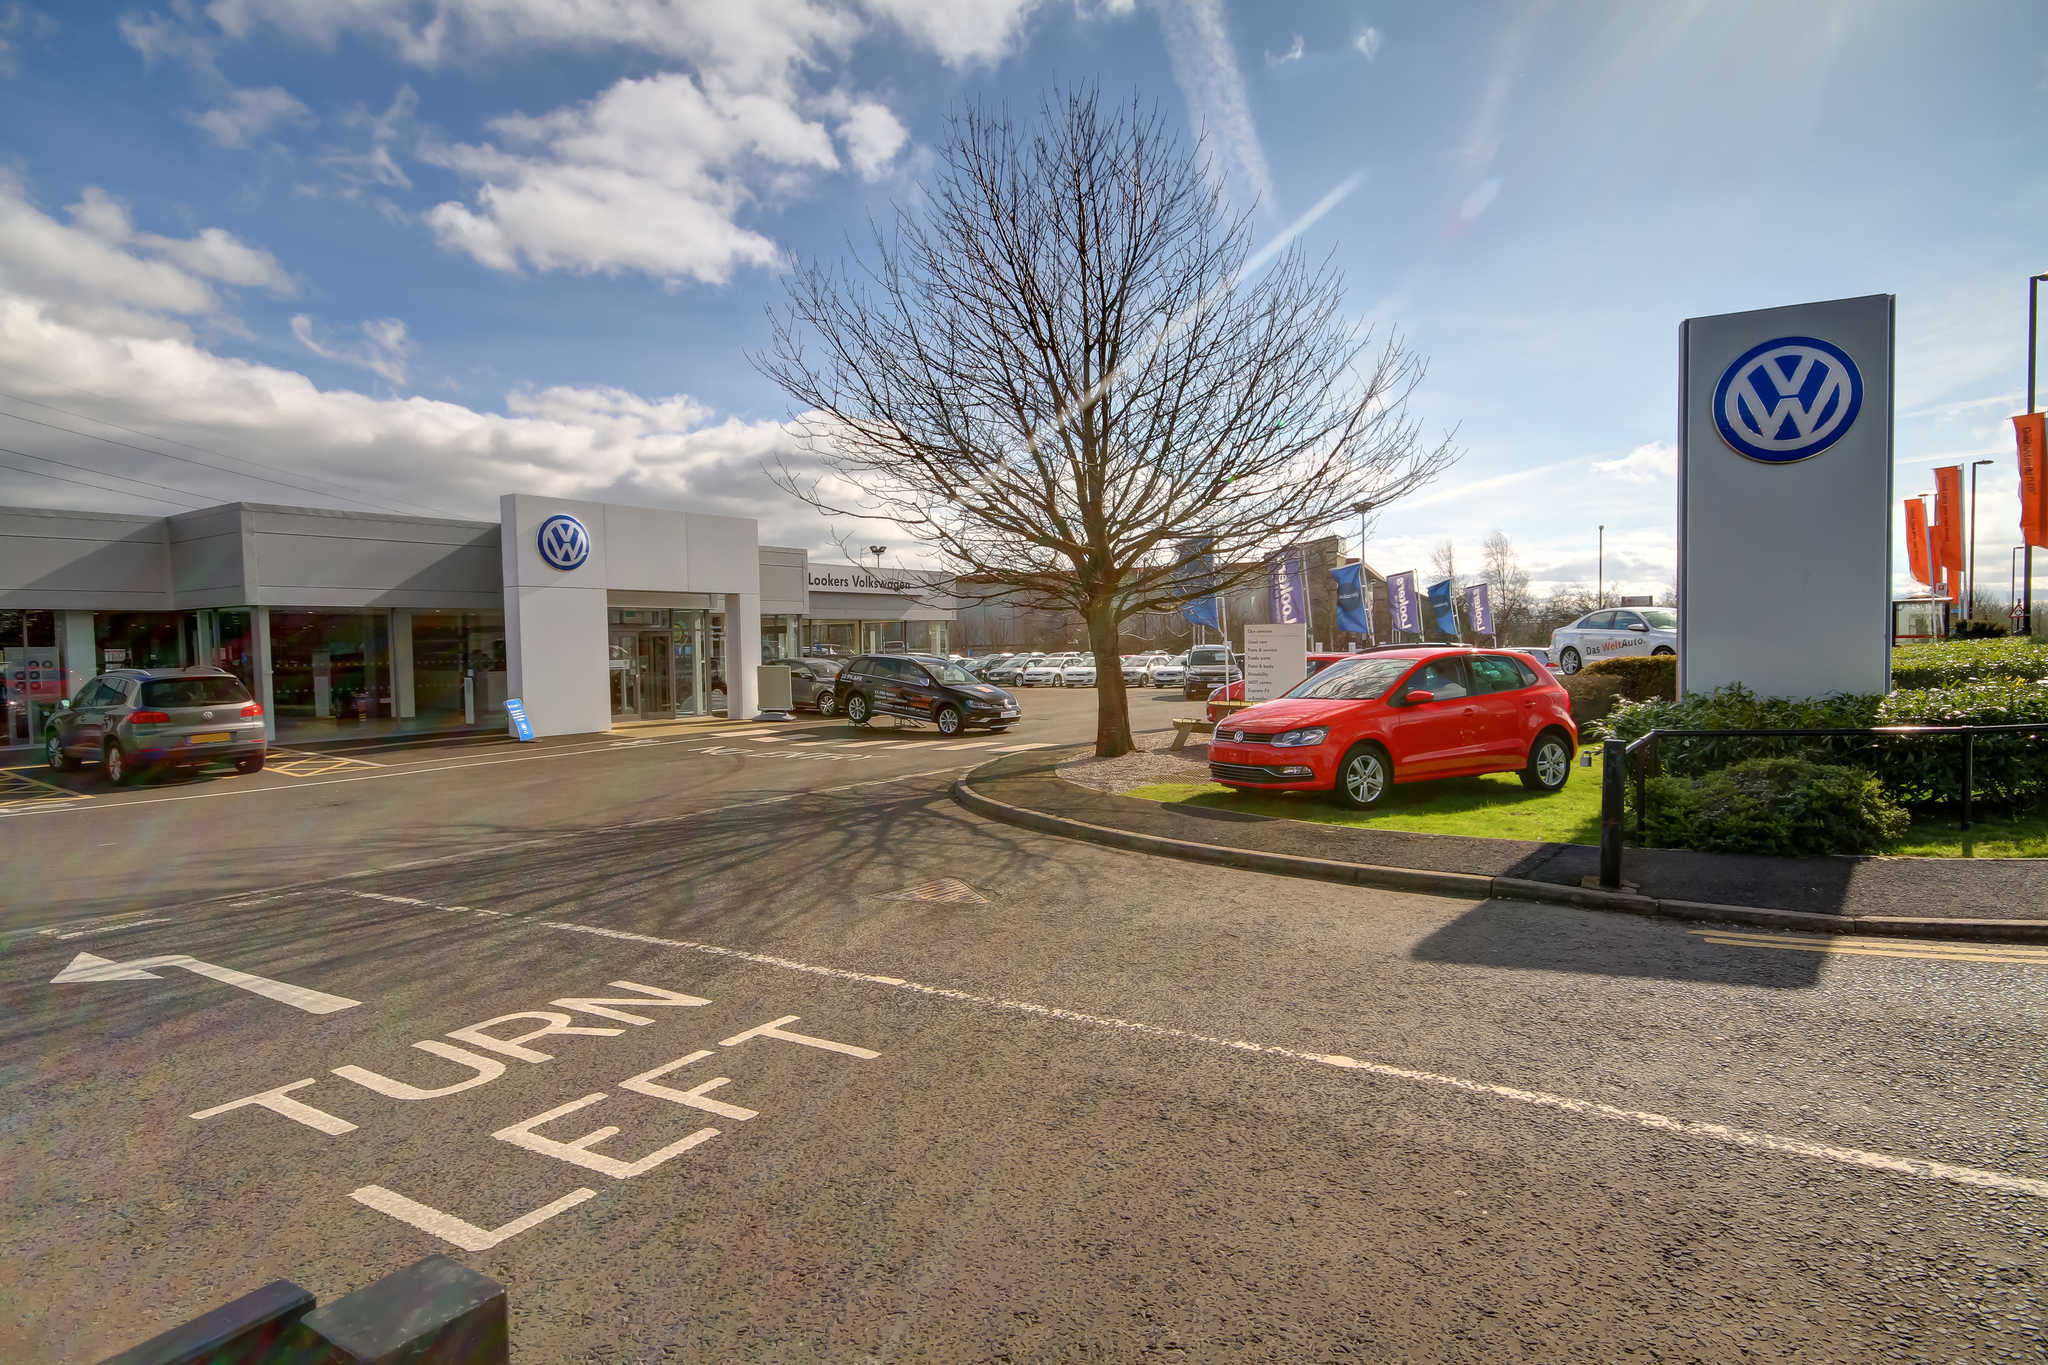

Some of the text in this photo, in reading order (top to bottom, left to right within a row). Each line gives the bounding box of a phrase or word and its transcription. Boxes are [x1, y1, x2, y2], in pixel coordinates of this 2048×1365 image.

[808, 572, 911, 591] Lookers Volkswagen
[1586, 646, 1600, 656] Das
[188, 980, 713, 1136] TURN
[349, 1014, 883, 1252] LEFT
